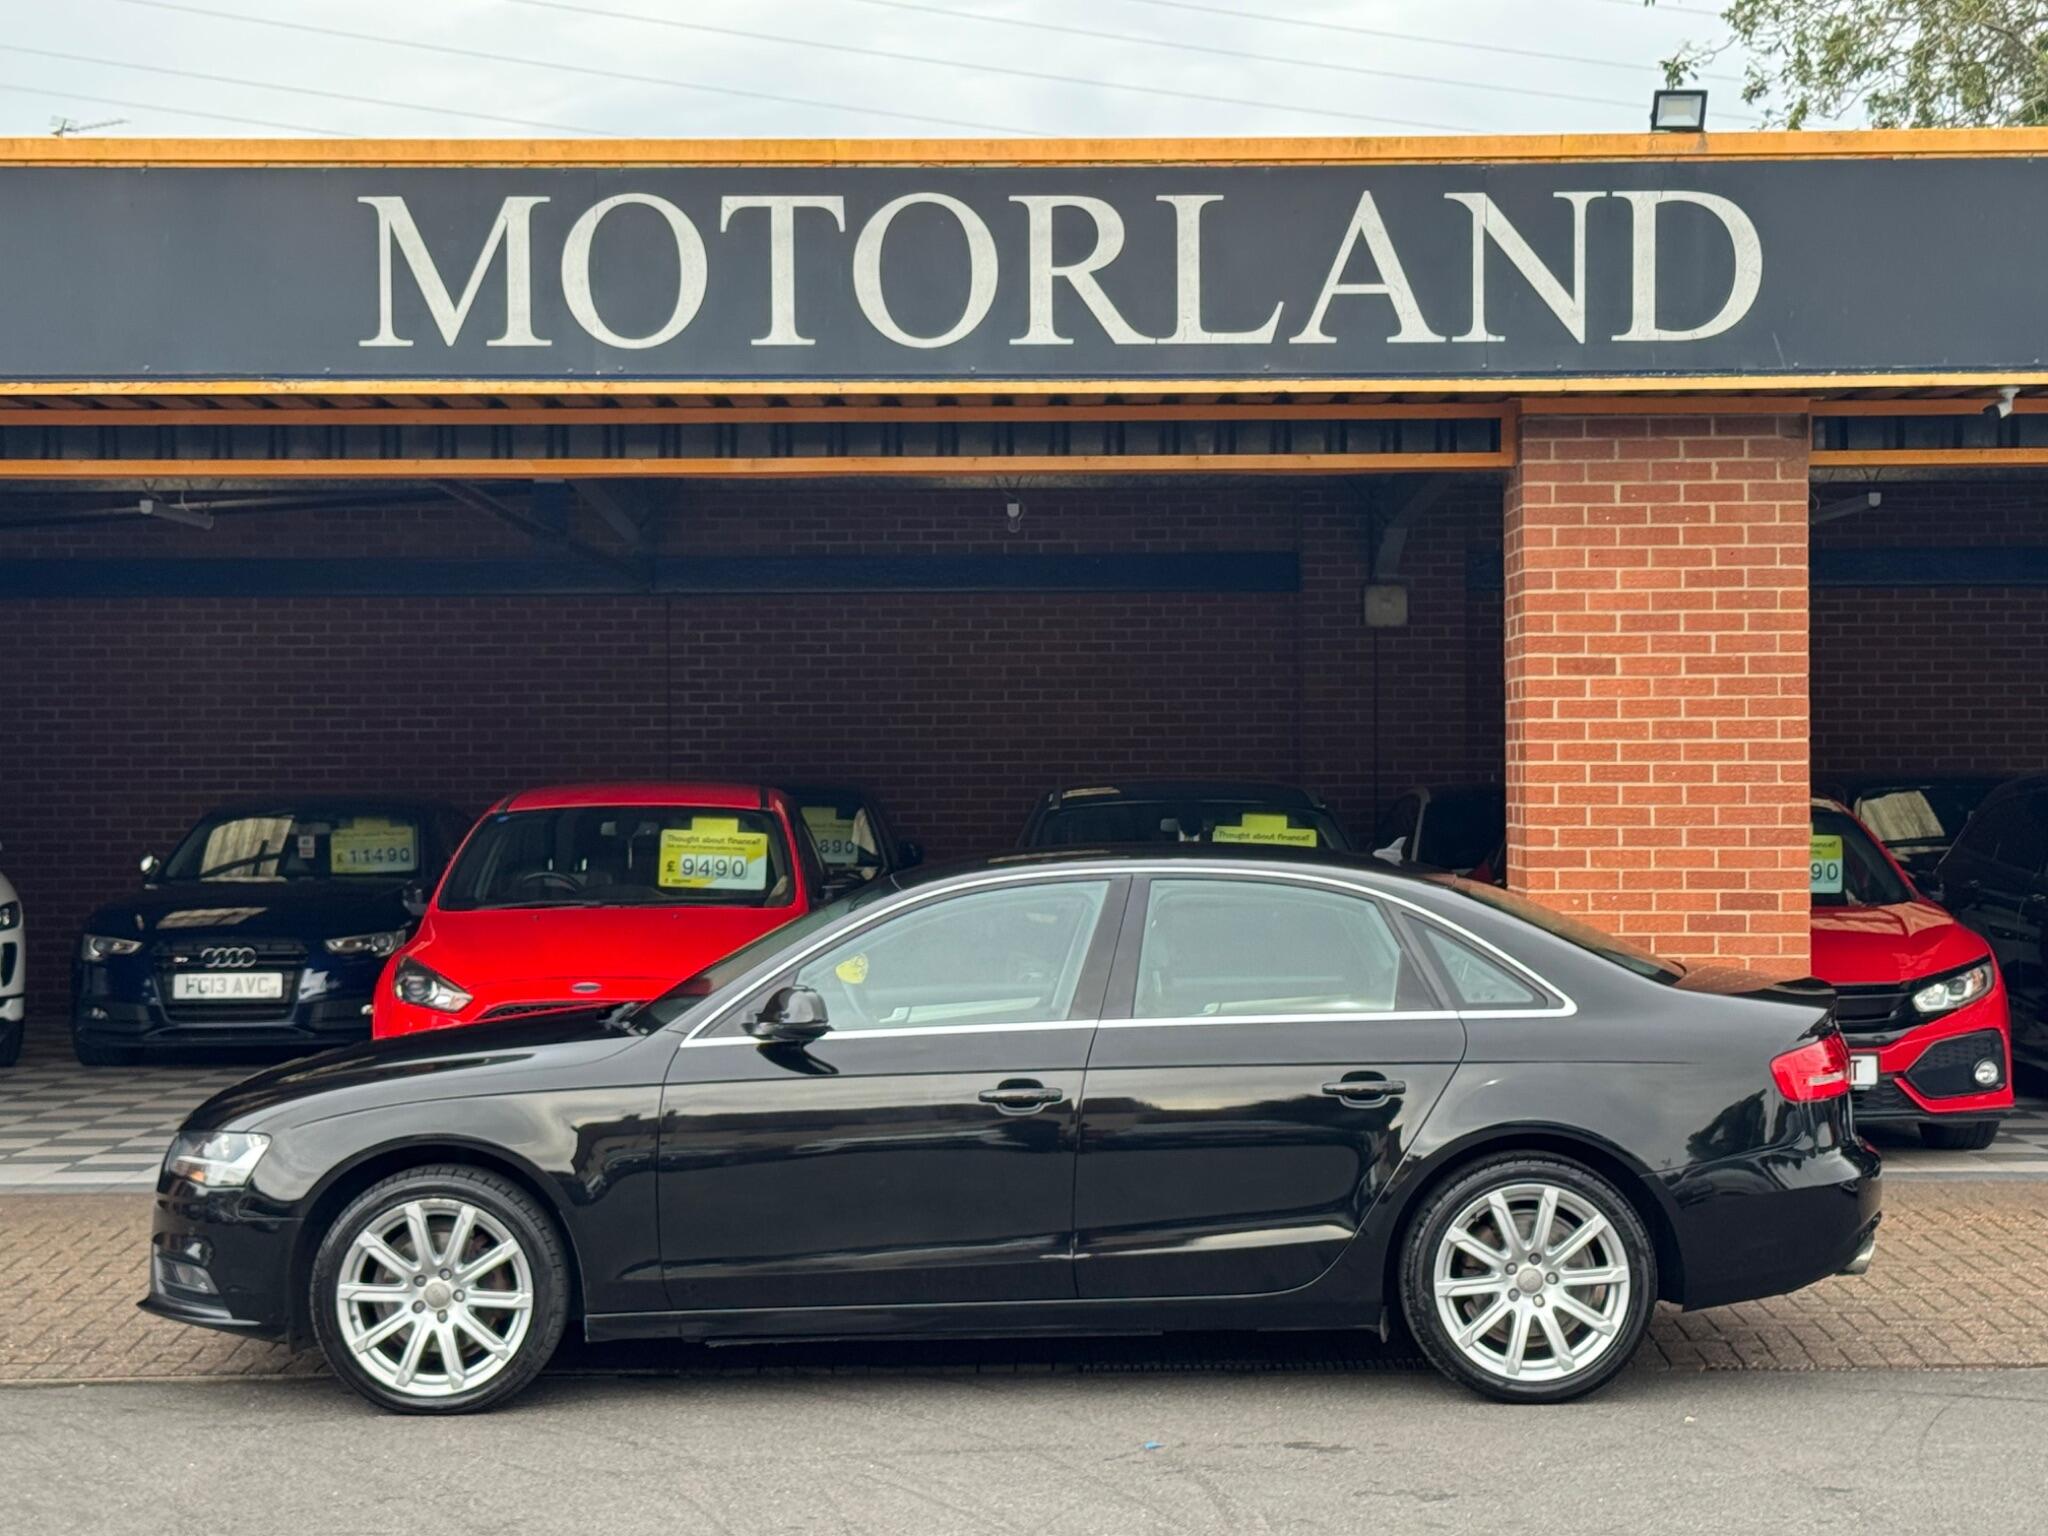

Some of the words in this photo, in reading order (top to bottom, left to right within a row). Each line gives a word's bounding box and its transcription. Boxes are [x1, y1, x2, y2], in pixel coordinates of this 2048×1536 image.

[357, 190, 1763, 350] MOTORLAND
[667, 834, 700, 844] Thought
[702, 836, 725, 844] about
[682, 858, 745, 877] 9490
